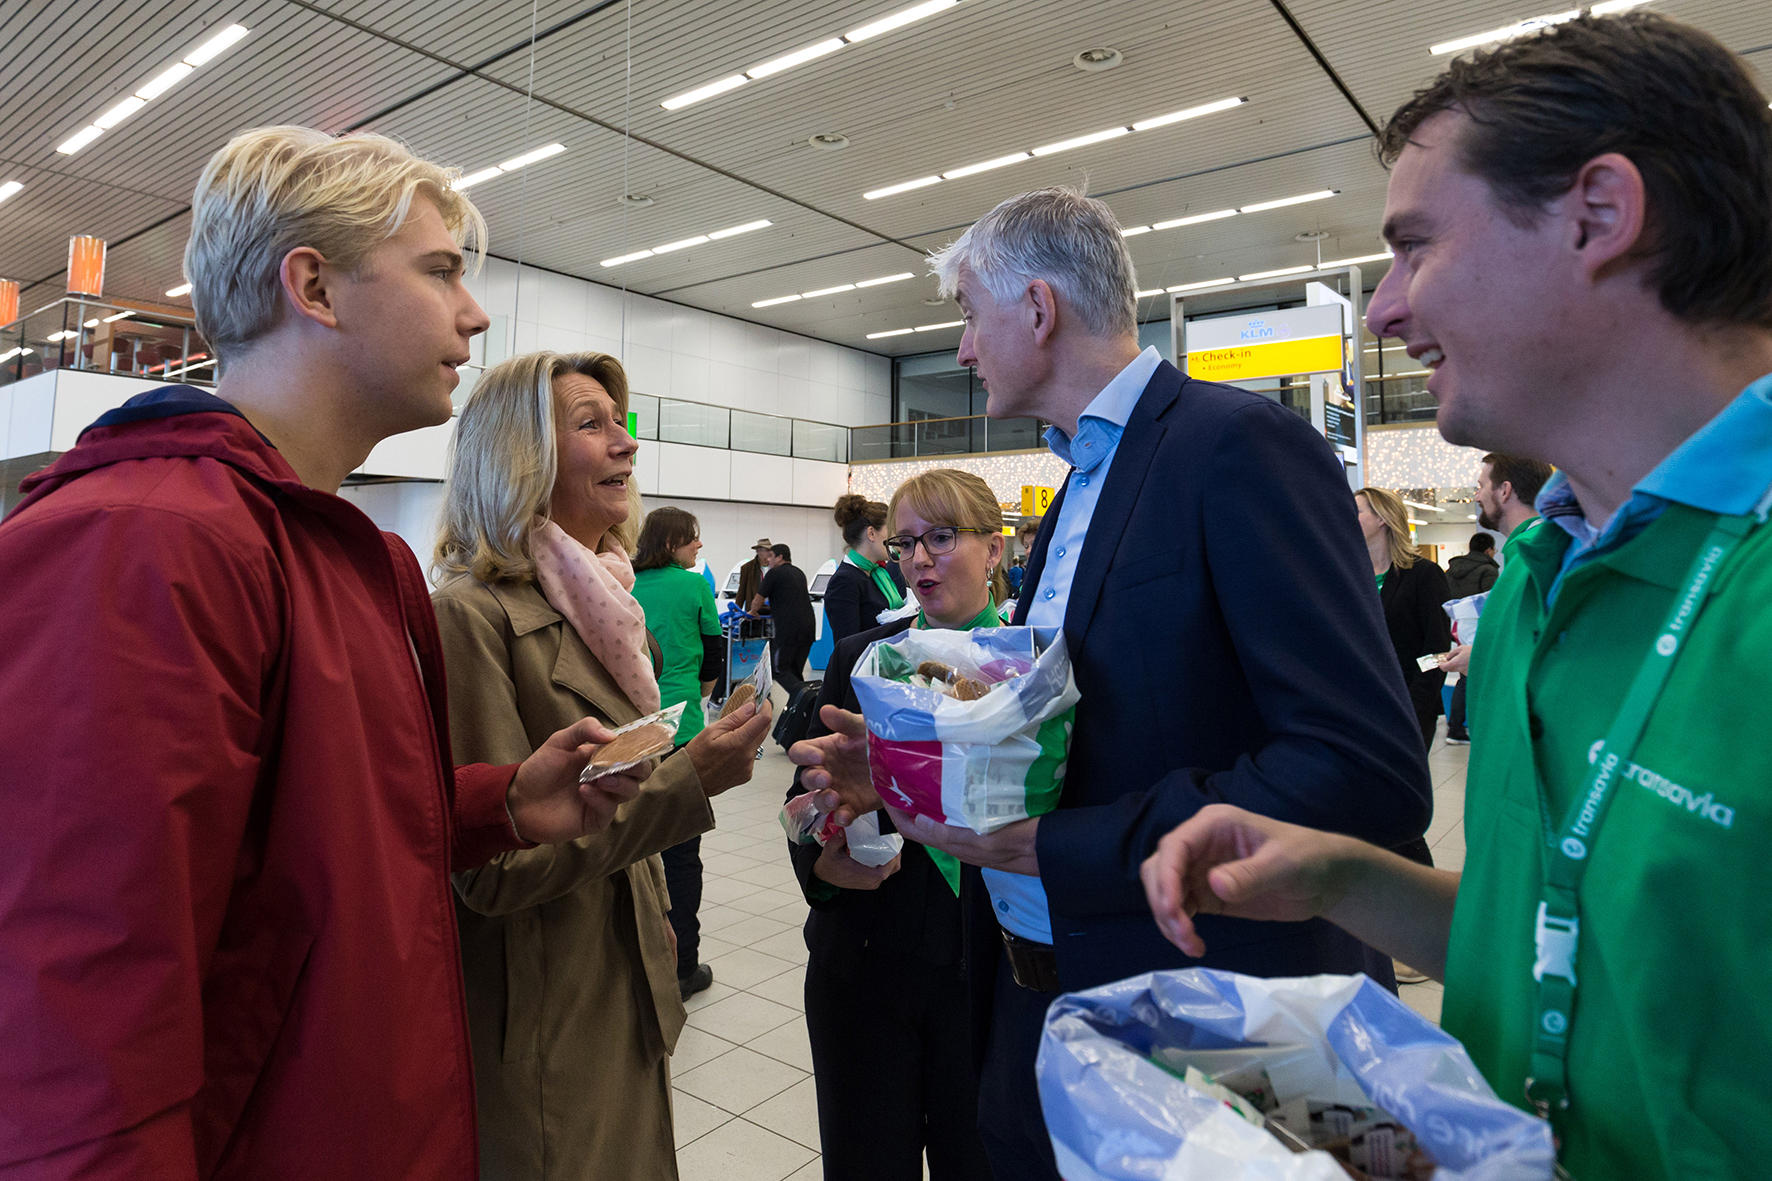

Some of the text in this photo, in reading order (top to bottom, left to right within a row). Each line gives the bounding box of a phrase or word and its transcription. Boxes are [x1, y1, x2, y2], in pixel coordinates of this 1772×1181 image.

[1240, 327, 1273, 339] KLM
[1202, 349, 1252, 362] Check-in
[1208, 363, 1242, 371] Economy
[1041, 489, 1047, 508] 8
[1669, 546, 1723, 631] transavia
[1571, 752, 1619, 837] transavia
[1623, 762, 1735, 829] ransavia
